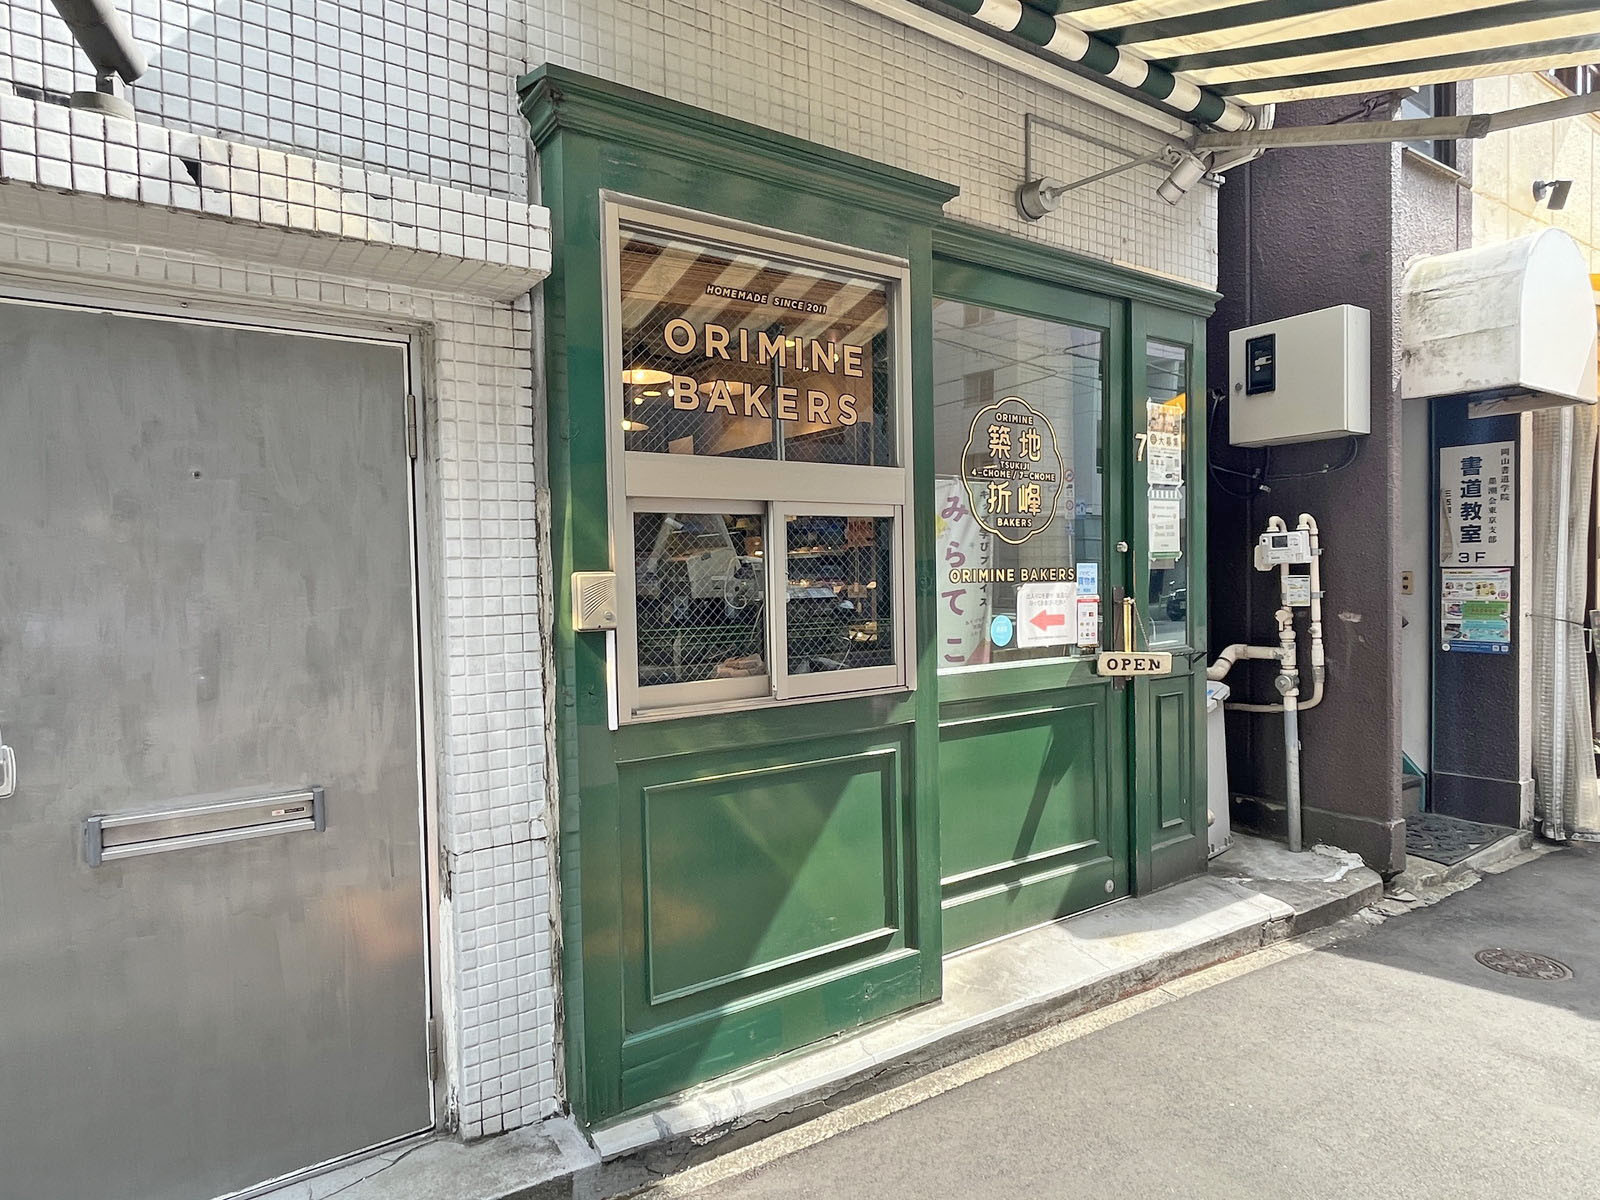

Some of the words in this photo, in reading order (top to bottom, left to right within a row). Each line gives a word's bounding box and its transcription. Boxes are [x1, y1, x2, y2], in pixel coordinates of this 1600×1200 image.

[706, 285, 768, 304] HOMEMADE
[773, 297, 804, 311] SINCE
[806, 303, 827, 314] 2011
[664, 318, 864, 378] ORIMINE
[673, 375, 859, 427] BAKERS
[995, 412, 1034, 425] ORIMINE
[988, 425, 1041, 462] 築地
[1135, 433, 1147, 462] 7
[971, 468, 1011, 479] 4-CHOME
[1019, 471, 1055, 481] 7-CHOME
[1000, 461, 1030, 470] TSUKIJI
[988, 481, 1041, 516] 折峰
[1460, 456, 1483, 544] 書道教室
[997, 518, 1032, 527] BAKERS
[1458, 552, 1486, 563] 3F
[941, 496, 969, 662] みらてこ
[949, 569, 1015, 584] ORIMINE
[1020, 568, 1075, 582] BAKERS
[1107, 658, 1161, 671] OPEN
